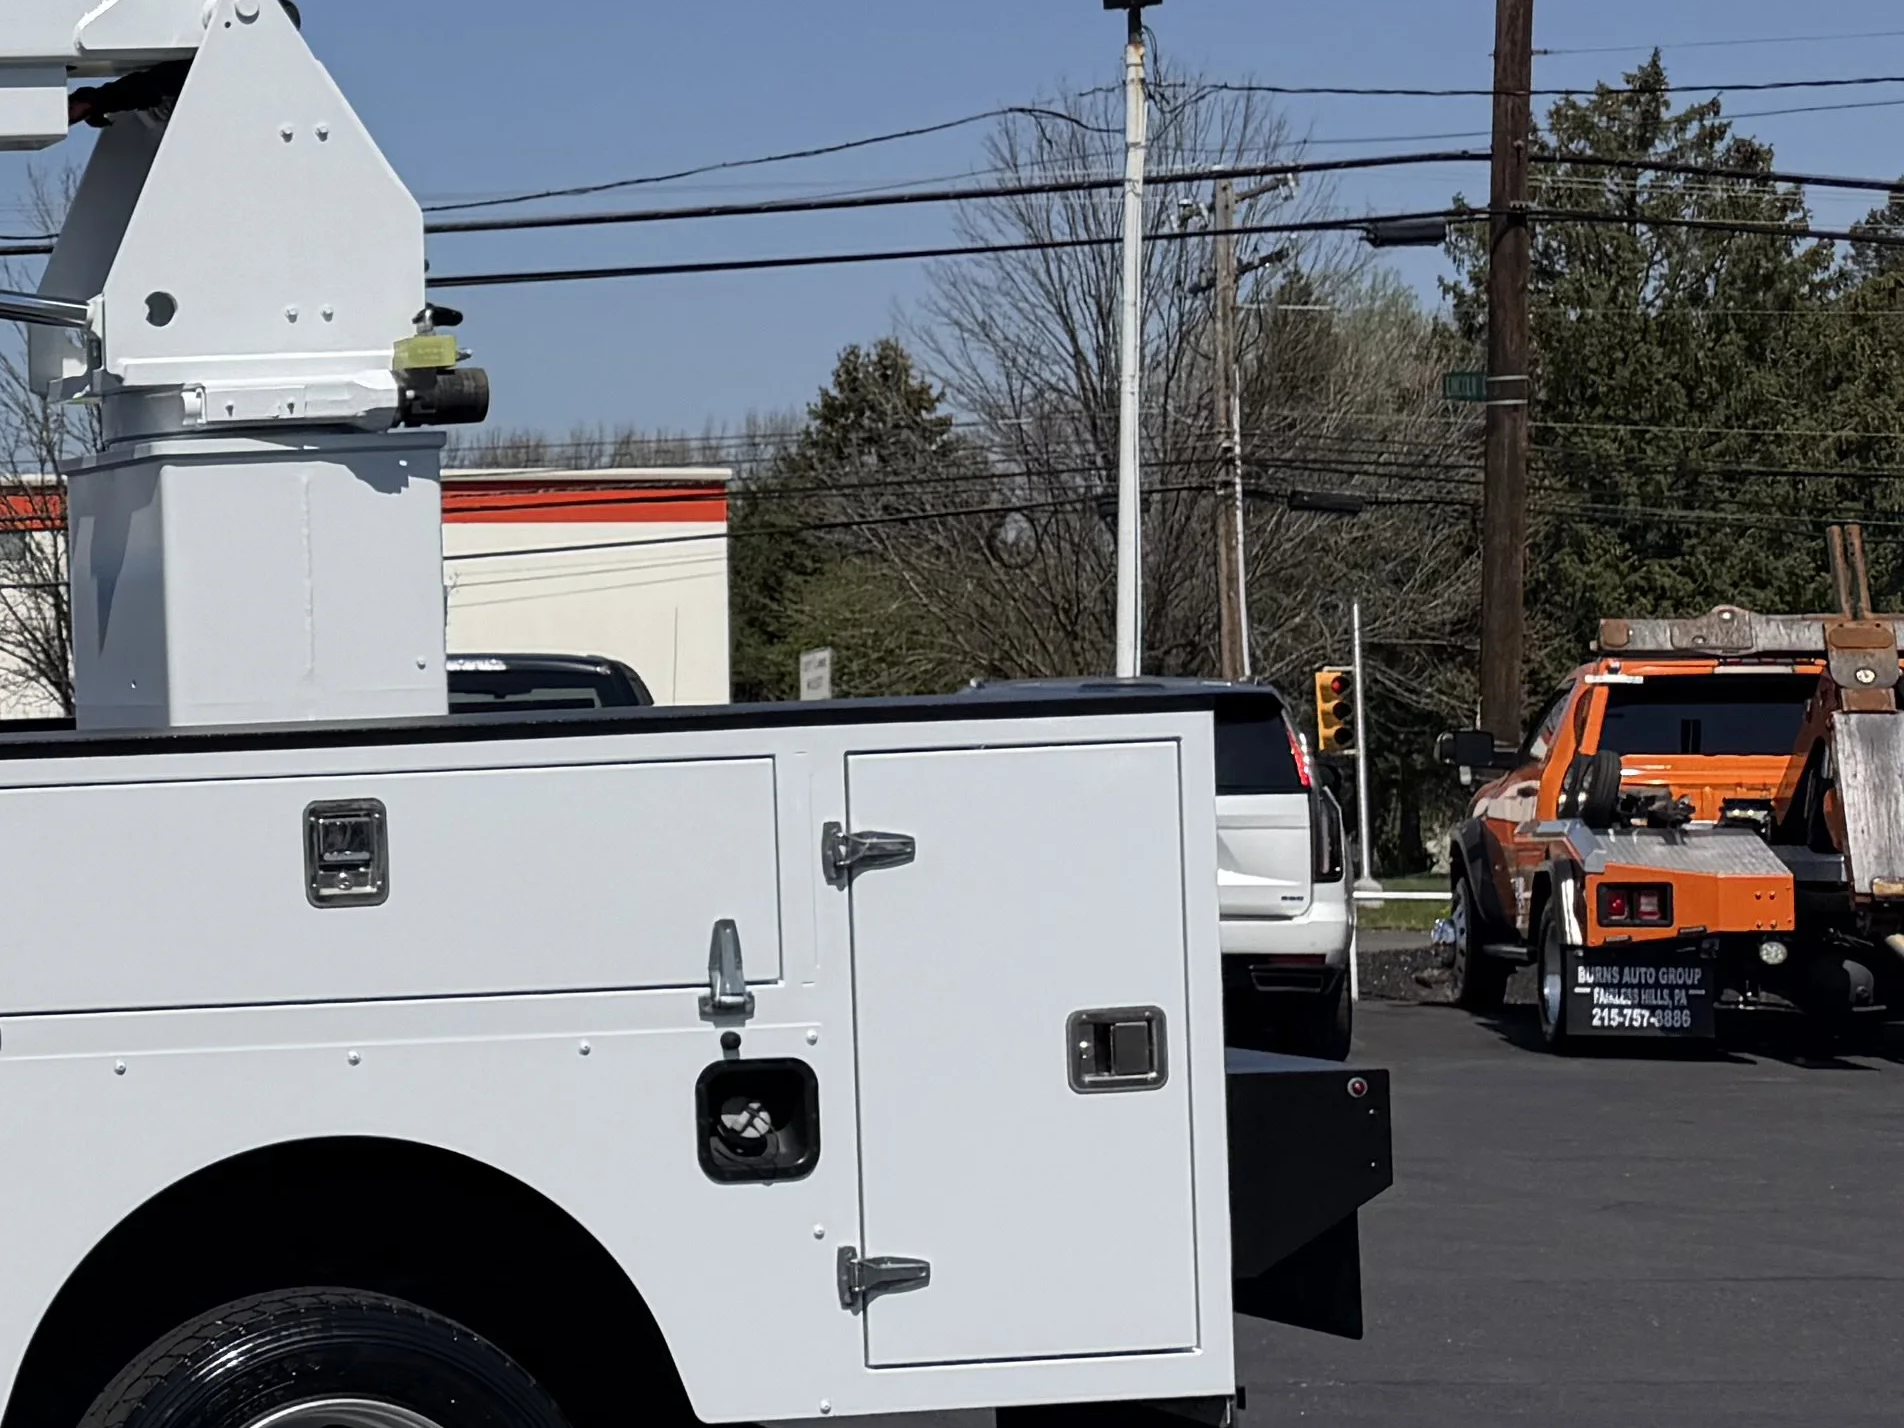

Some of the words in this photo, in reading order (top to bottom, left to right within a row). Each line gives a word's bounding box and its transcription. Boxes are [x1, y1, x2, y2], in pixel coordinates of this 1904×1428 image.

[1577, 966, 1620, 984] BURNS
[1622, 966, 1656, 984] AUTO
[1658, 967, 1702, 985] GROUP
[1641, 988, 1673, 1007] HILLS,
[1674, 989, 1688, 1006] PA
